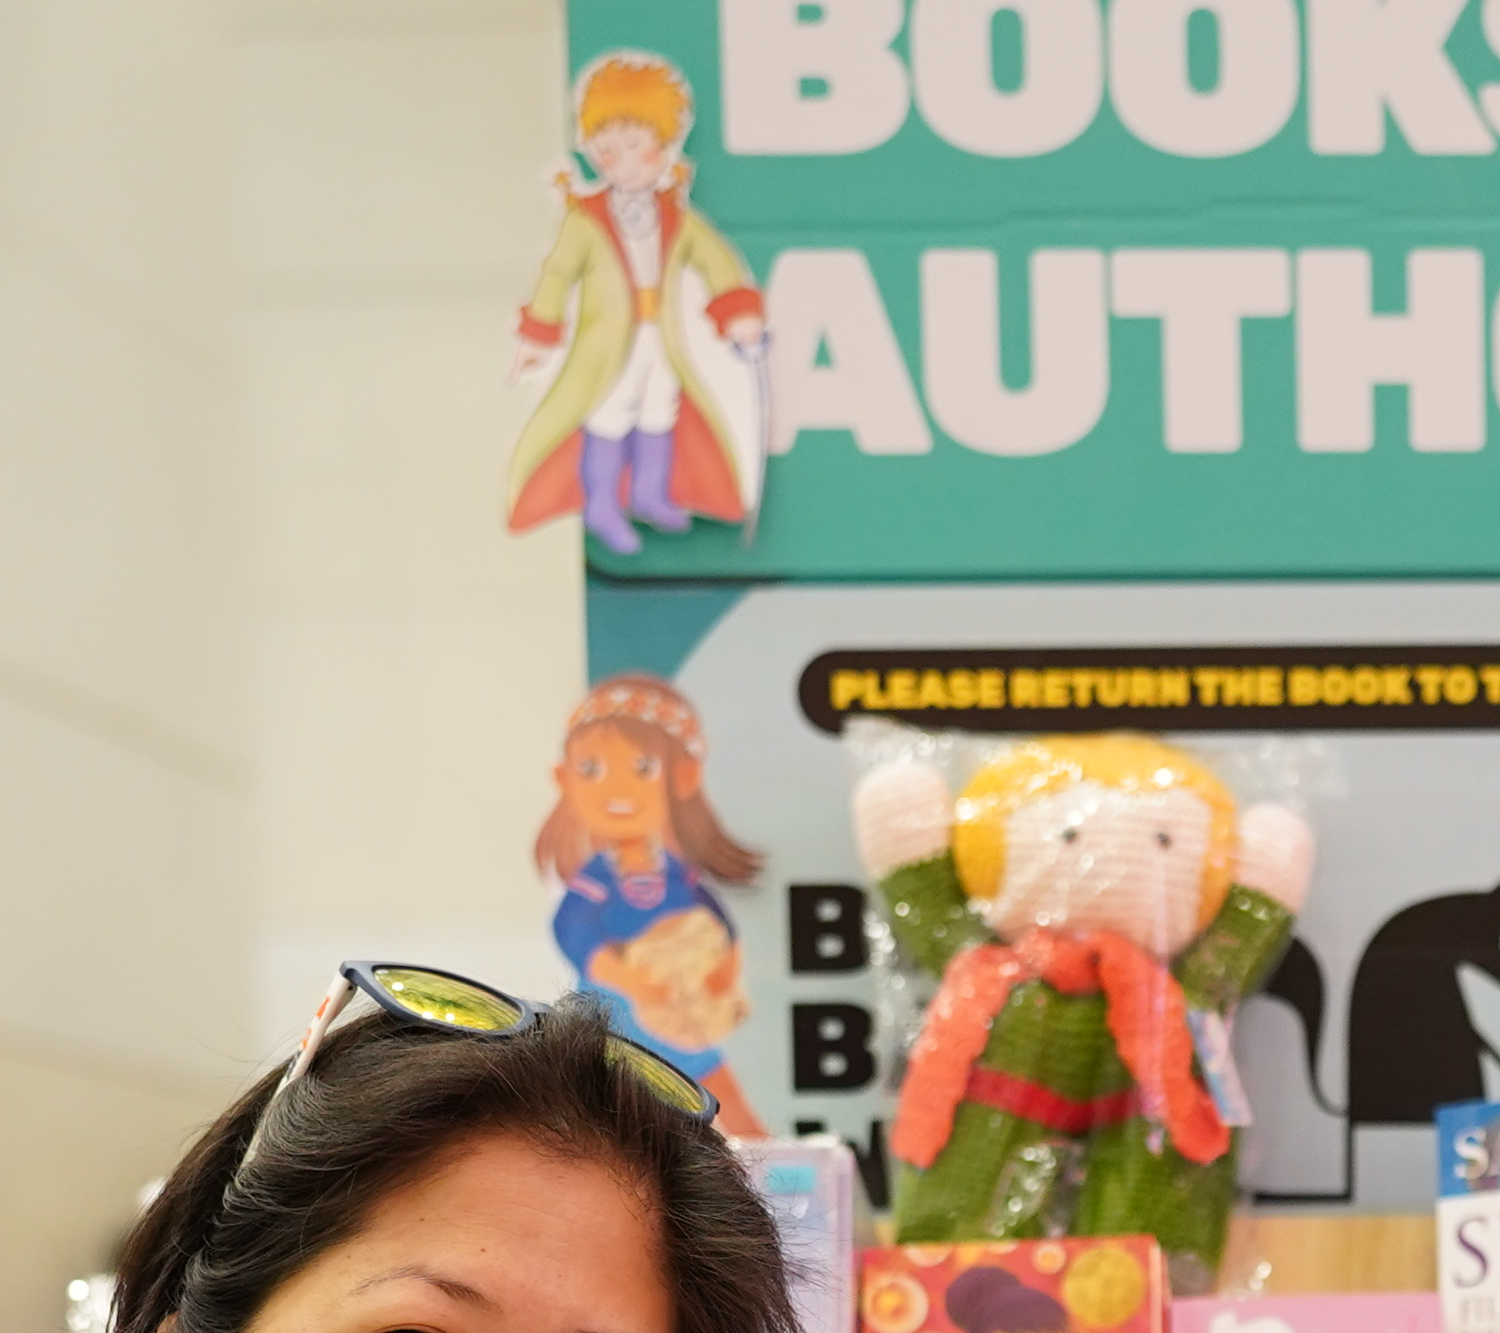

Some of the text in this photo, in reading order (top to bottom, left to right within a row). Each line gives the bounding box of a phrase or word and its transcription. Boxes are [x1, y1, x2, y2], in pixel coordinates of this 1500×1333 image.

[831, 667, 1007, 711] PLEASE
[1010, 666, 1189, 709] RETURN
[1194, 665, 1283, 707] THE
[1288, 664, 1409, 706] BOOK
[1412, 664, 1478, 705] TO
